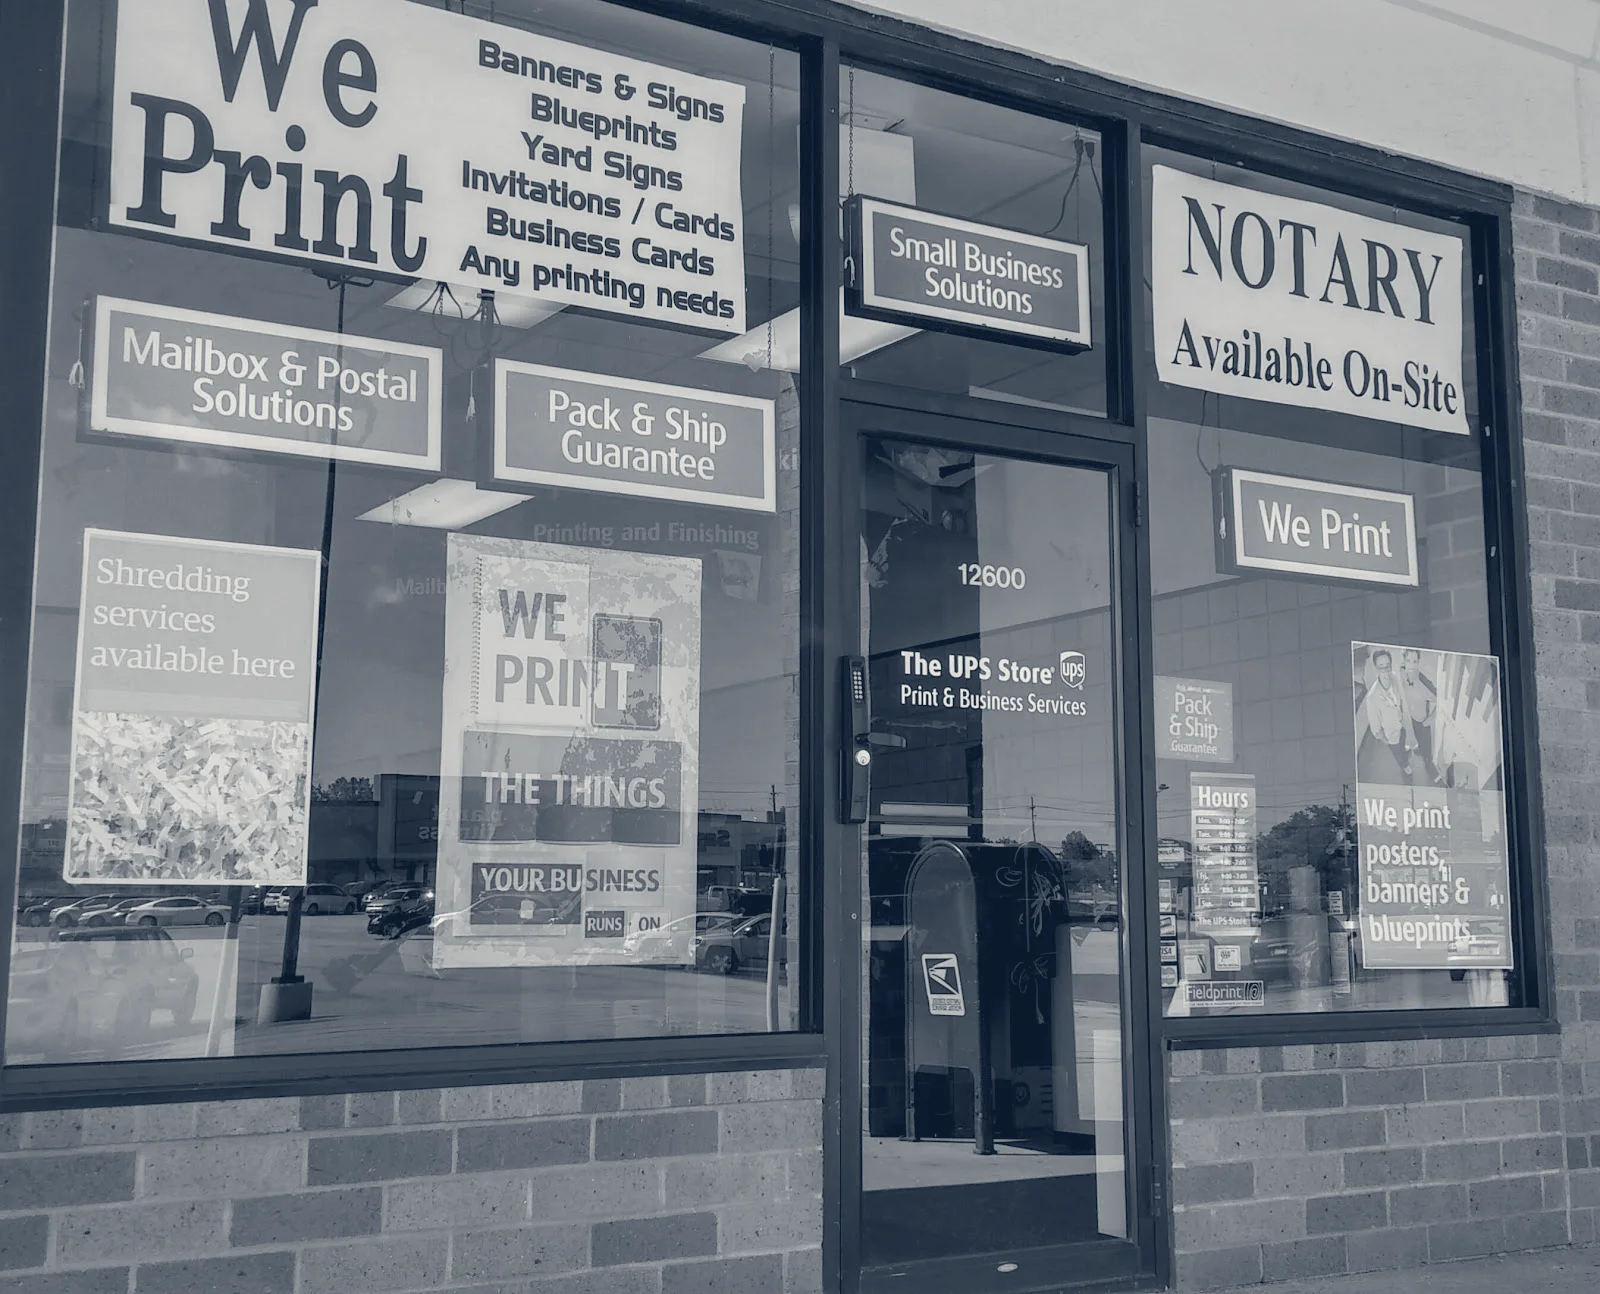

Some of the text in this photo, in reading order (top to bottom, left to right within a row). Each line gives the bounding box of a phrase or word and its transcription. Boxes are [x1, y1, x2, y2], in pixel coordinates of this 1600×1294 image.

[208, 0, 378, 128] We
[478, 39, 724, 124] Banners & Signs
[531, 93, 677, 151] Blueprints
[126, 92, 427, 272] Print
[520, 131, 683, 191] Yard Signs
[462, 160, 621, 219] Invitations
[655, 202, 735, 242] Cards
[486, 206, 714, 276] Business Cards
[890, 227, 1064, 289] Small Business
[1181, 195, 1443, 325] NOTARY
[459, 245, 735, 319] Any printing needs
[924, 267, 1033, 315] Solutions
[122, 326, 418, 402] Mailbox & Postal
[1171, 318, 1458, 416] Available On-Site
[192, 378, 354, 431] Solutions
[548, 389, 727, 454] Pack & Ship
[561, 429, 715, 481] Guarantee
[533, 523, 760, 550] Printing and Finishing
[1257, 499, 1393, 559] We Print
[96, 558, 250, 602] Shredding
[957, 563, 1026, 590] 12600
[93, 603, 216, 634] services
[498, 589, 567, 642] WE
[90, 643, 295, 679] available here
[495, 654, 636, 710] PRINT
[901, 651, 1051, 685] The UPS Store
[901, 684, 1087, 716] Print & Business Services
[1174, 692, 1212, 716] Pack
[1169, 714, 1218, 744] & Ship
[1171, 740, 1218, 755] Guarantee
[481, 771, 666, 810] THE THINGS
[1198, 785, 1249, 809] Hours
[1363, 798, 1452, 835] We print
[481, 867, 660, 893] YOUR BUSINESS
[1367, 876, 1449, 904] banners
[1455, 877, 1470, 904] &
[587, 916, 661, 932] RUNS ON
[1186, 982, 1241, 1002] Fieldprint
